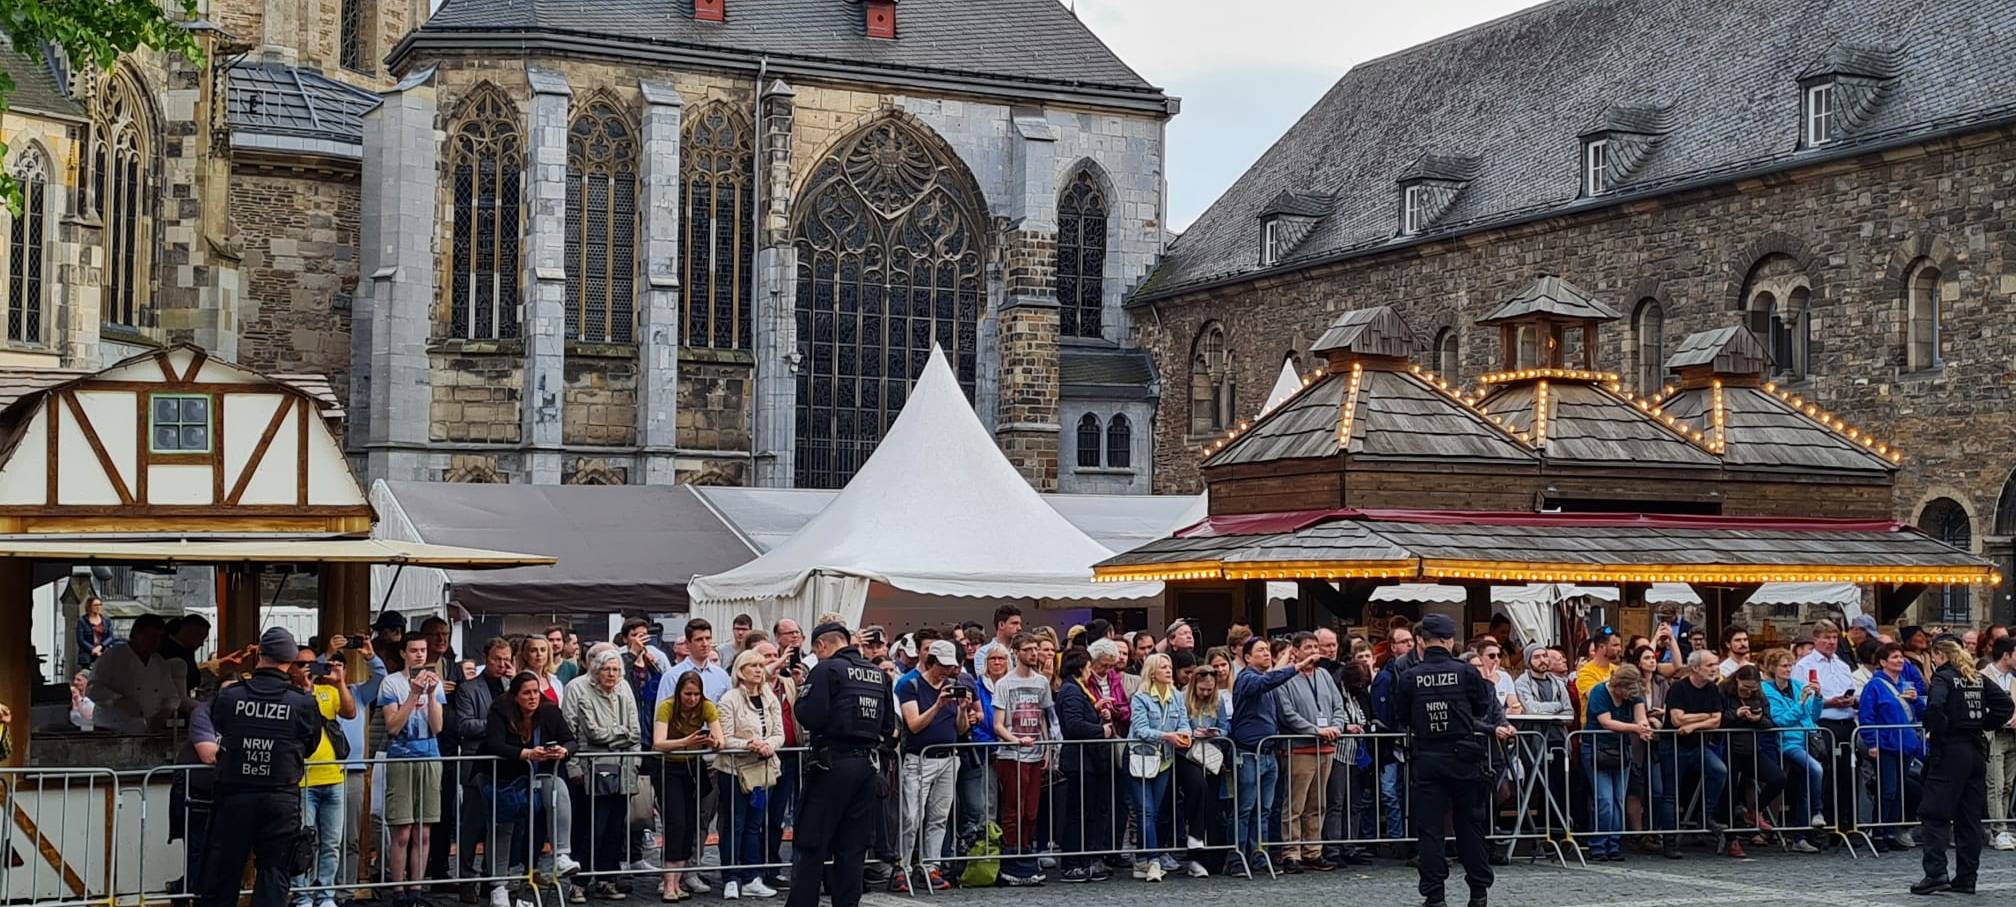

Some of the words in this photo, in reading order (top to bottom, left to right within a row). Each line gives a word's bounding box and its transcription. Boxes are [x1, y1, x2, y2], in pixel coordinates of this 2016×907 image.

[848, 667, 882, 685] POLIZEI
[1416, 673, 1458, 688] POLIZEI
[859, 695, 878, 708] NRW
[1426, 701, 1448, 712] NRW
[235, 700, 291, 720] POLIZEI
[1429, 711, 1448, 721] 1413
[1430, 721, 1449, 732] FLT
[243, 738, 275, 751] NRW
[246, 750, 271, 763] 1413
[242, 763, 271, 776] BeSi
